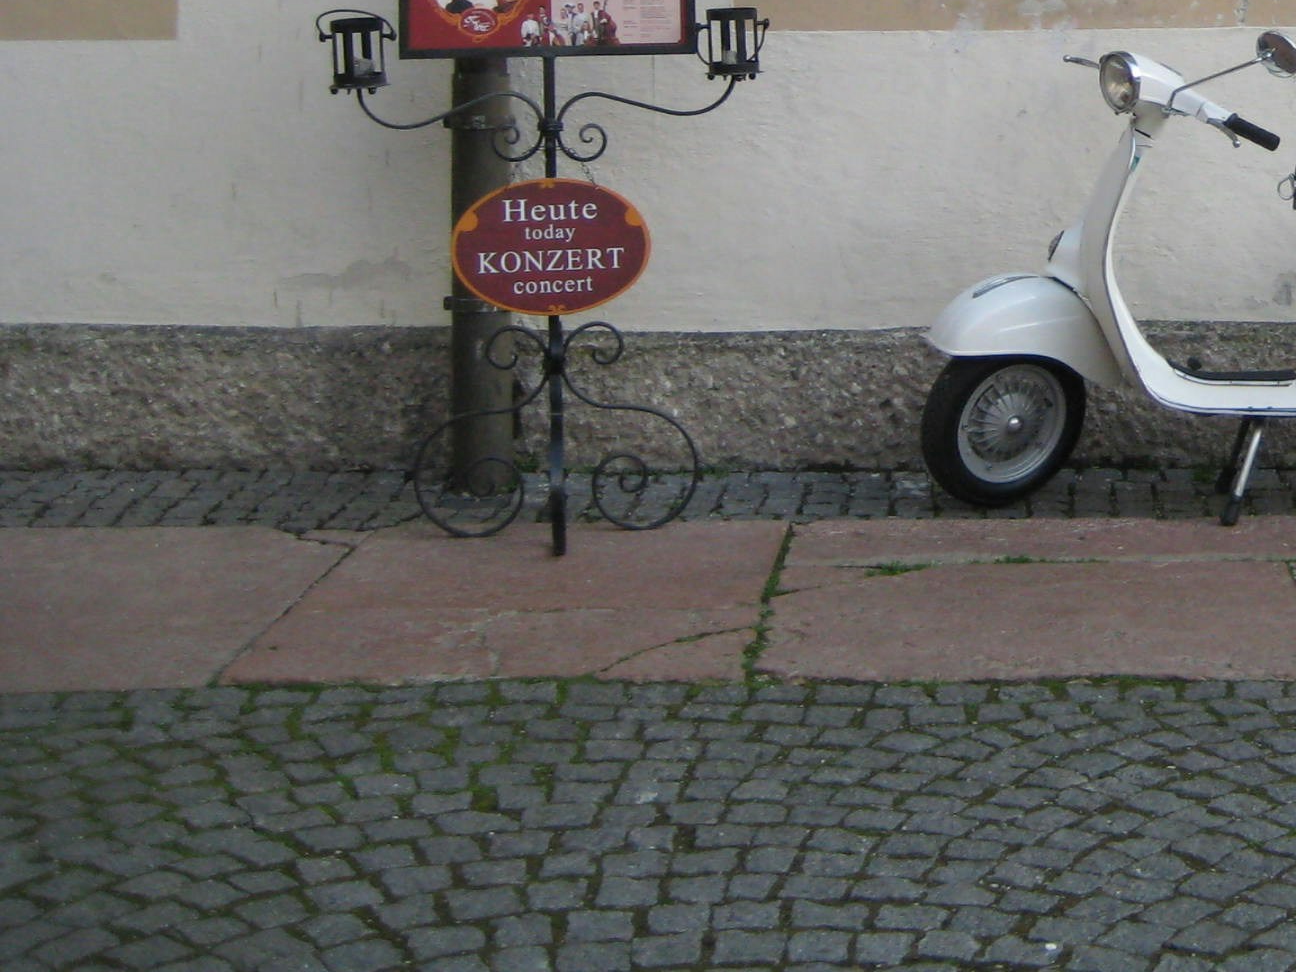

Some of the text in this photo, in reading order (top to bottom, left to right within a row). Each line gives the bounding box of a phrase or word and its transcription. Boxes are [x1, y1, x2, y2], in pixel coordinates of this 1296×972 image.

[501, 199, 599, 223] Heute
[524, 224, 576, 243] today
[477, 247, 625, 275] KONZERT
[513, 275, 594, 295] concert
